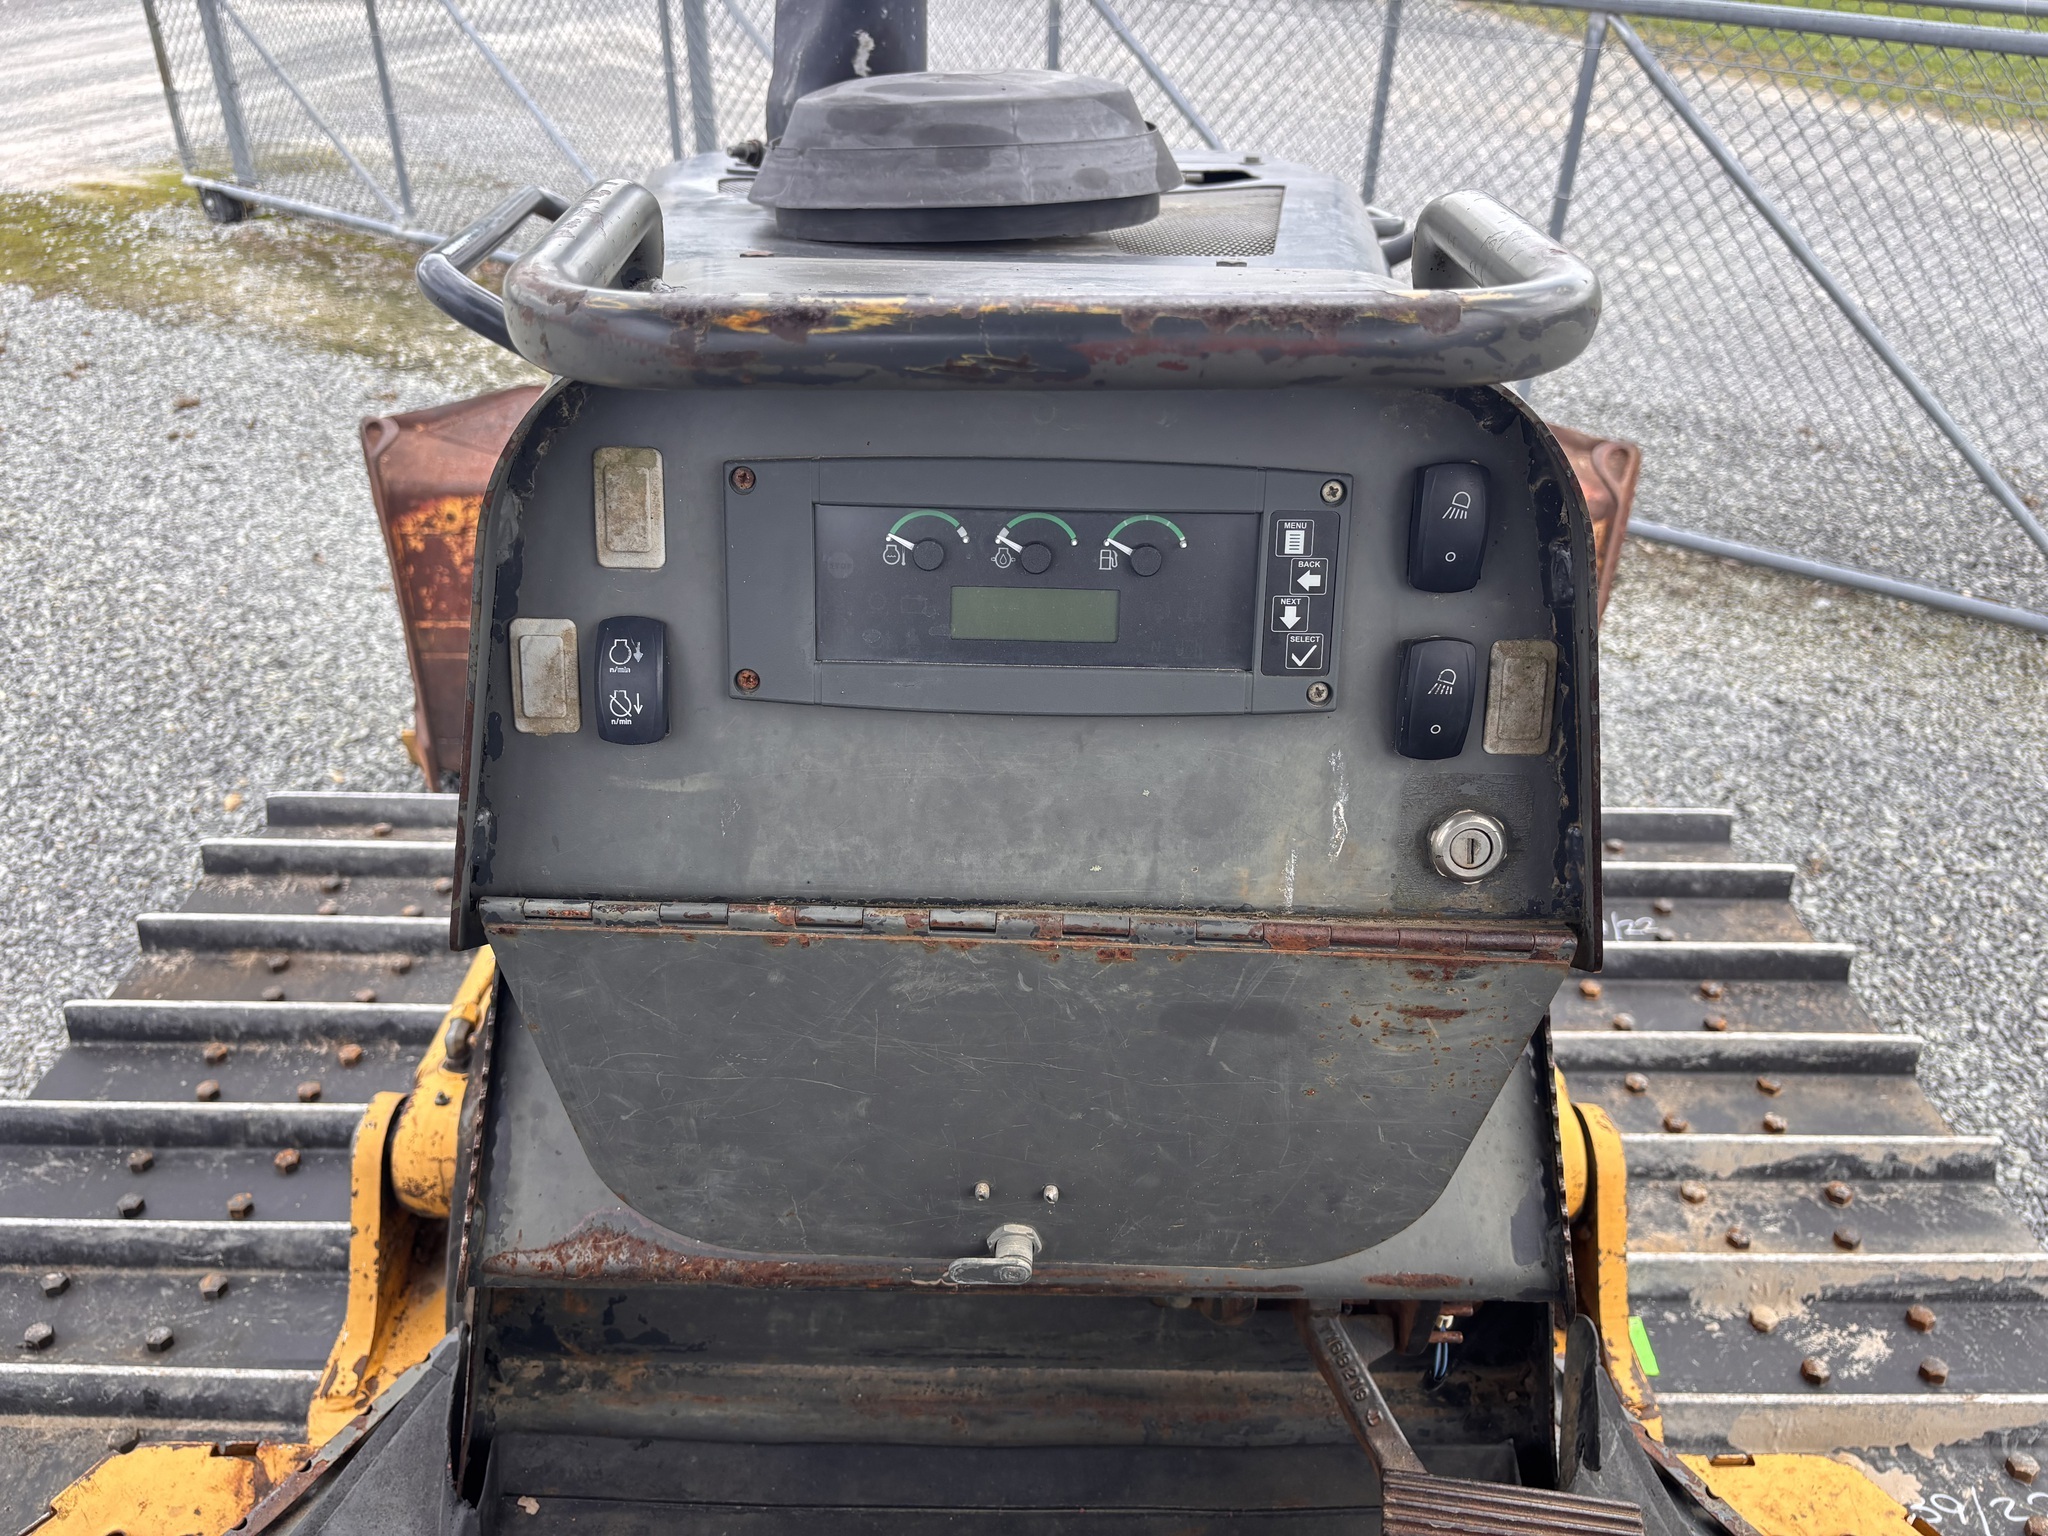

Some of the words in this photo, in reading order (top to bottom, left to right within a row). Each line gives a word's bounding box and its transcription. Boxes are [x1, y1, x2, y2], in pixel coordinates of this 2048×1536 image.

[1284, 521, 1307, 529] MENU
[1298, 560, 1321, 568] BACK
[1290, 635, 1320, 643] SELECT
